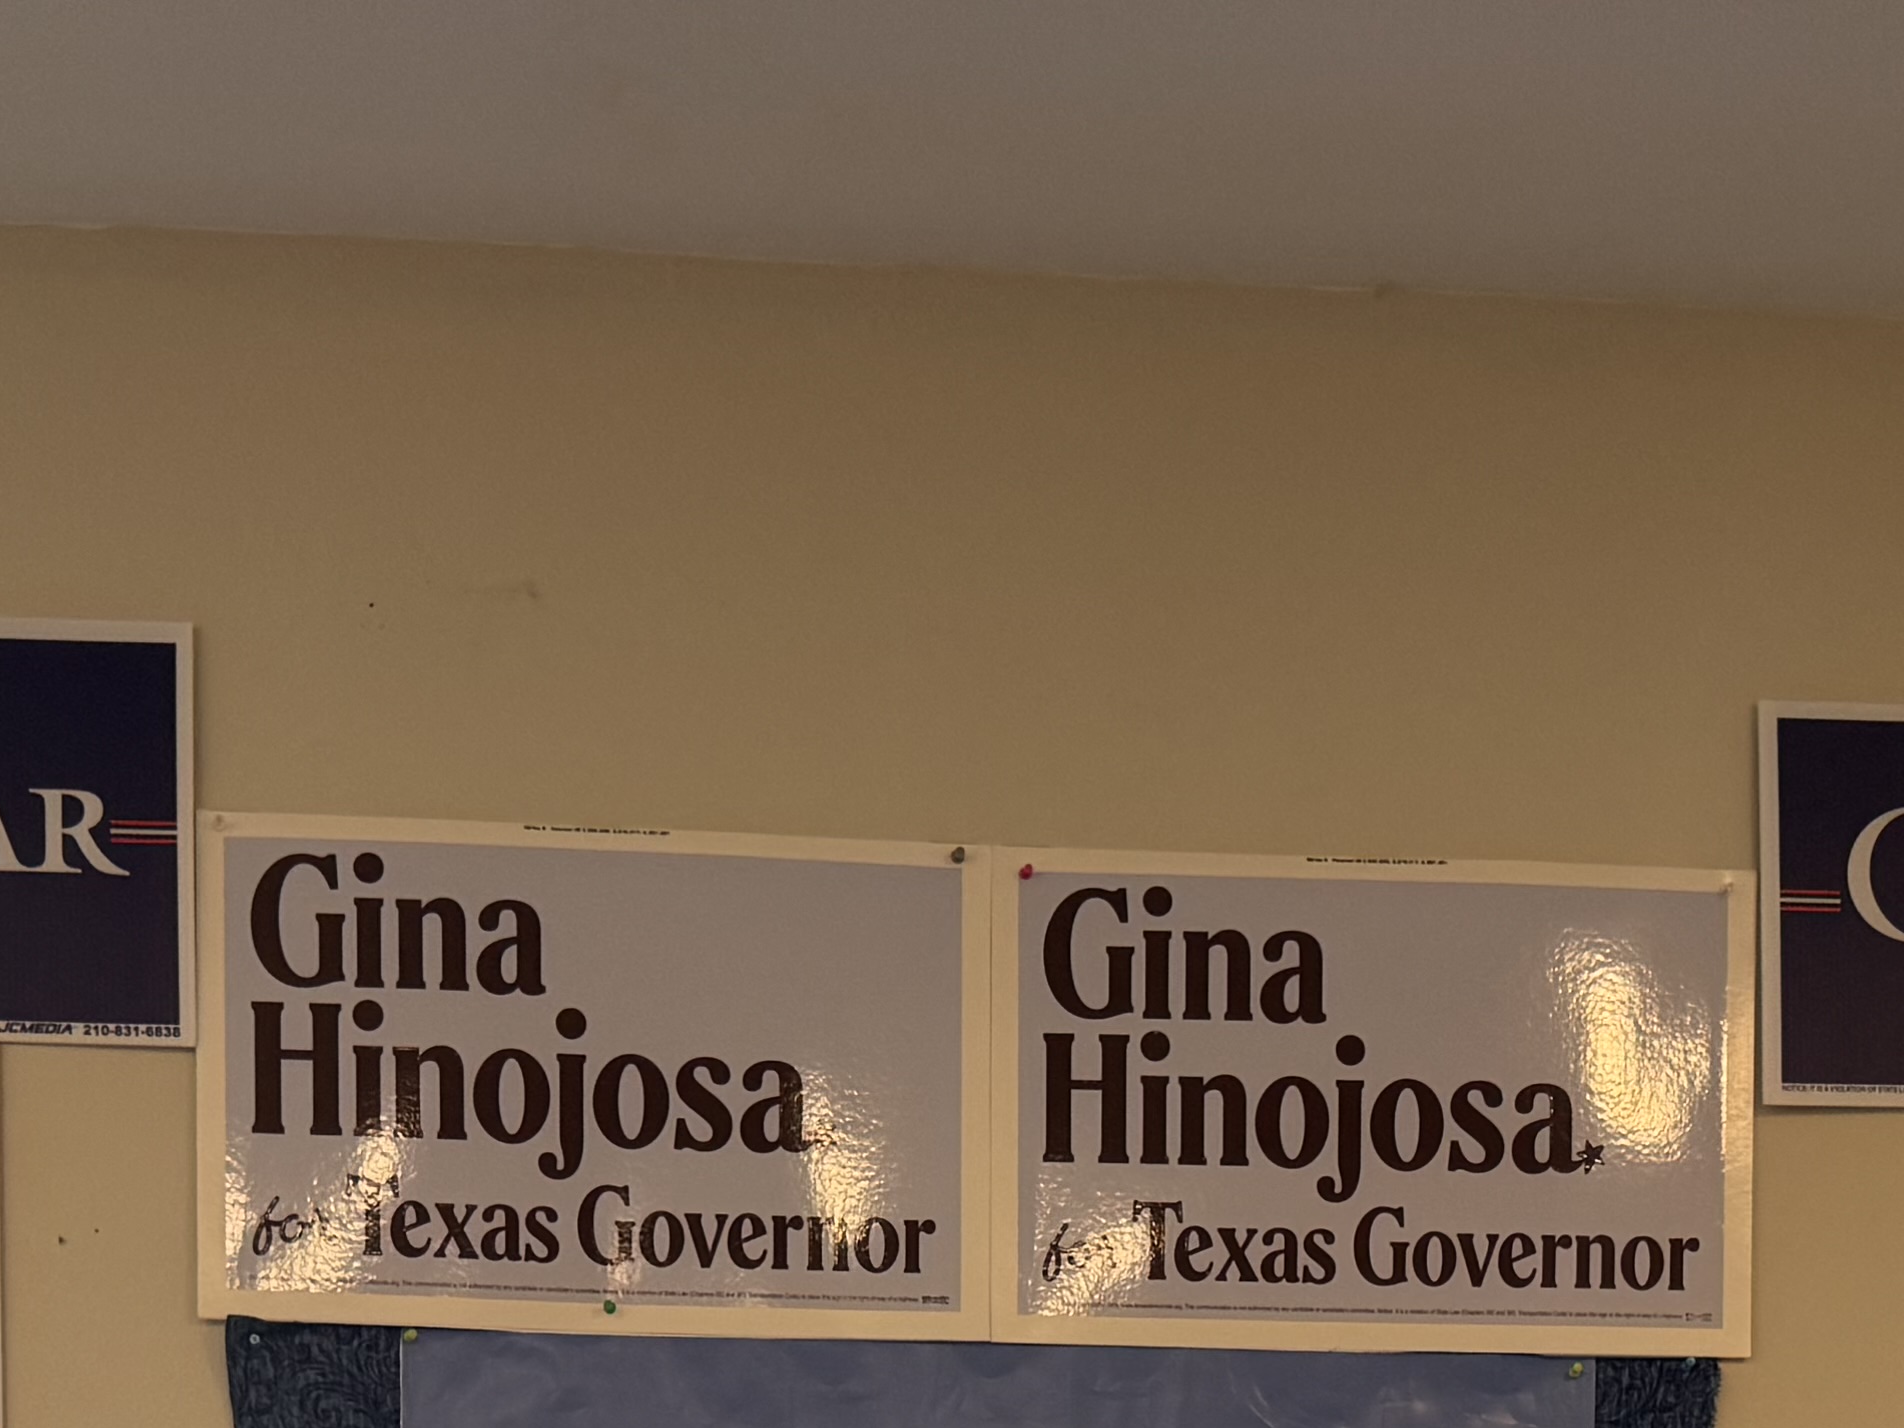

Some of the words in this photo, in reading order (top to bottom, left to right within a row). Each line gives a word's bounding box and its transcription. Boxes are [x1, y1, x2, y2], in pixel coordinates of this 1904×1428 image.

[250, 852, 546, 996] Gina
[1043, 886, 1327, 1025] Gina
[251, 1000, 812, 1181] Hinojosa
[1042, 1032, 1582, 1203] Hinojosa
[345, 1173, 560, 1265] Texas
[577, 1184, 936, 1275] Governor
[1132, 1200, 1337, 1286] Texas
[1354, 1206, 1700, 1292] Governor
